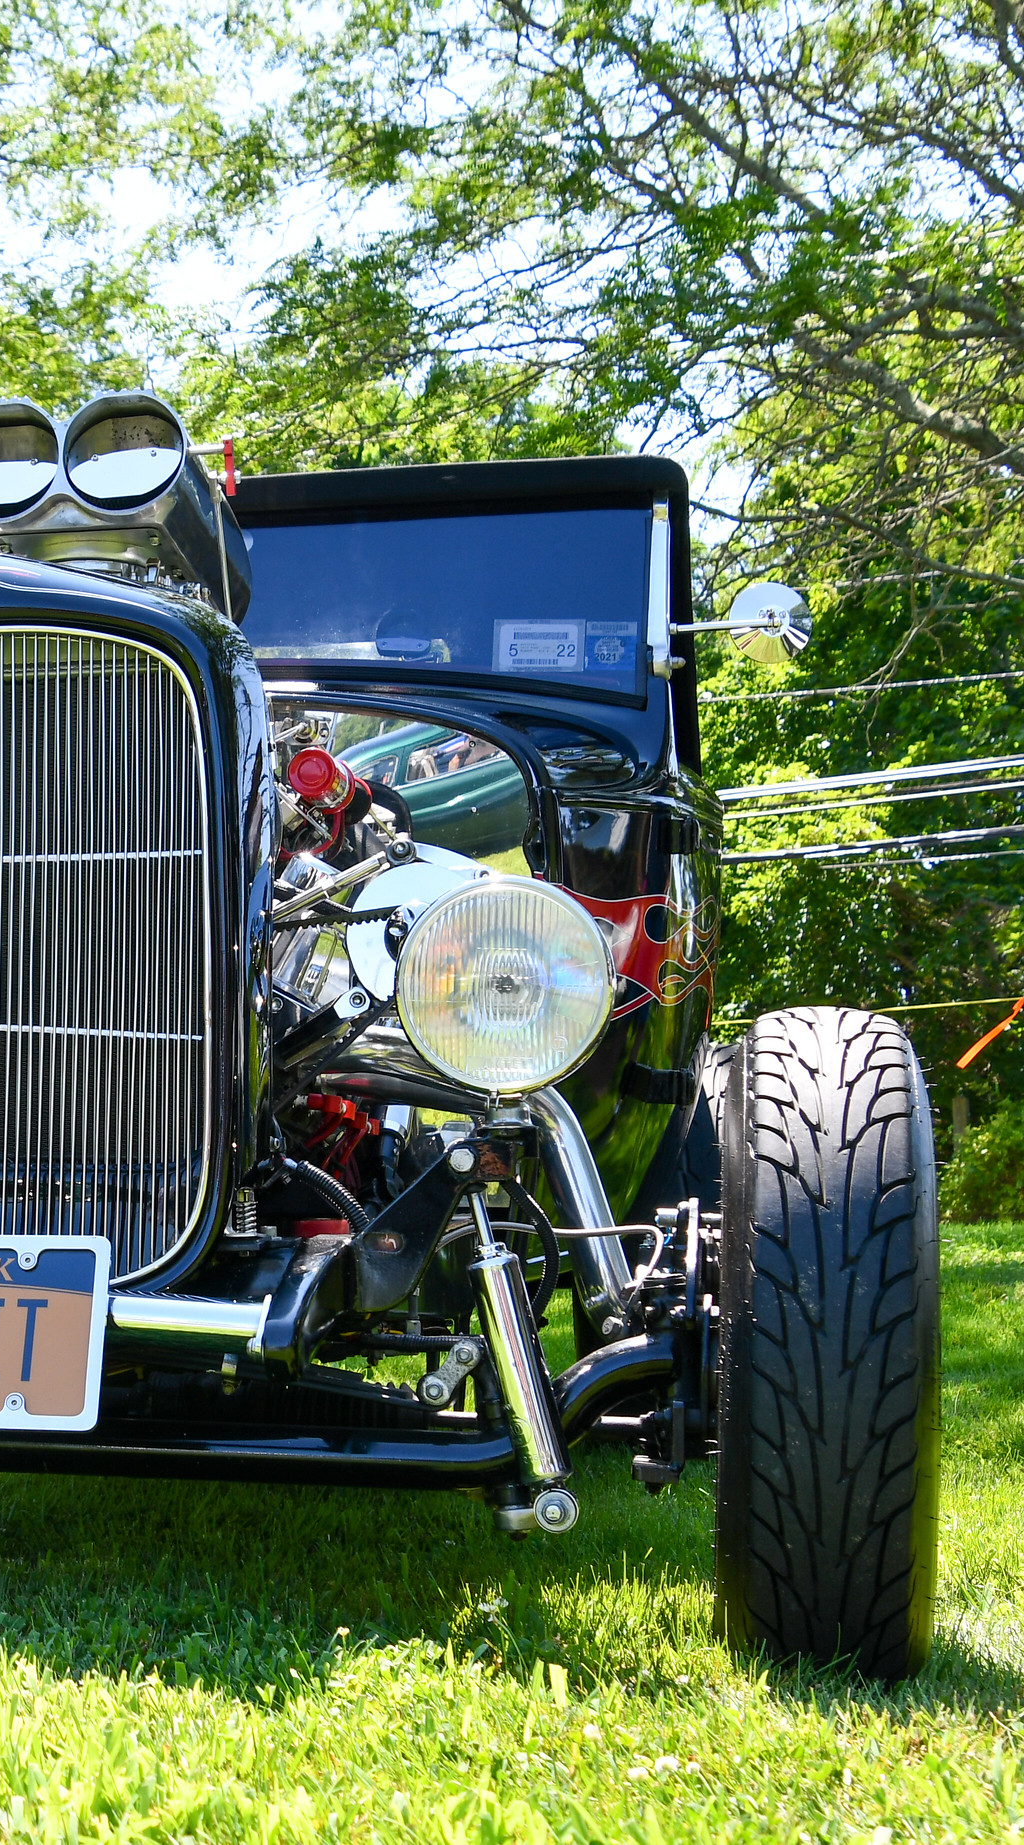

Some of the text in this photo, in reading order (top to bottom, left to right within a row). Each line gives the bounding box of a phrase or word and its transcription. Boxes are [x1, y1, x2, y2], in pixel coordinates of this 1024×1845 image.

[509, 644, 518, 656] 5
[556, 644, 576, 657] 22
[594, 653, 616, 661] 2021
